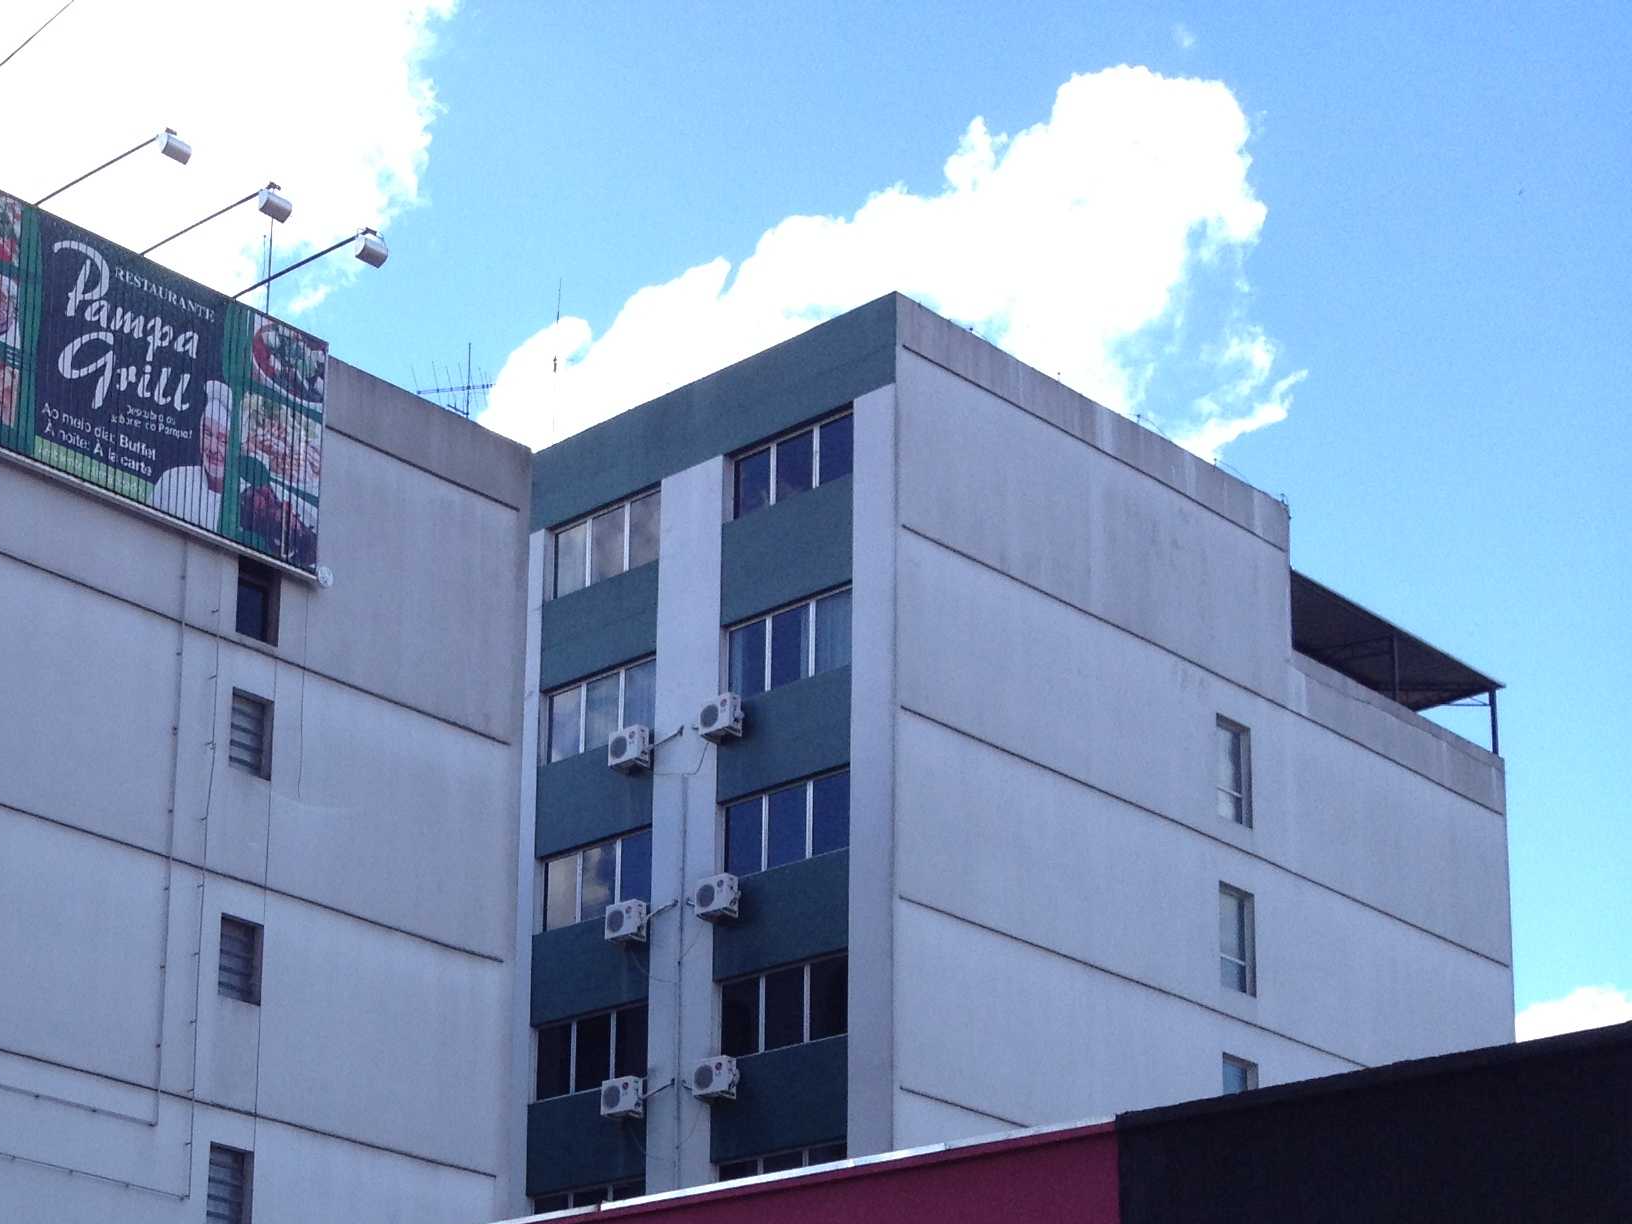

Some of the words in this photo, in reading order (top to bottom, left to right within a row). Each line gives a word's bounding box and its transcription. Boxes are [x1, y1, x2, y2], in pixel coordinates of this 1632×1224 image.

[54, 240, 199, 361] Pampa
[115, 267, 215, 323] RESTAURANTE
[58, 331, 191, 411] Grill
[119, 434, 156, 461] Buffet
[120, 455, 152, 478] carte
